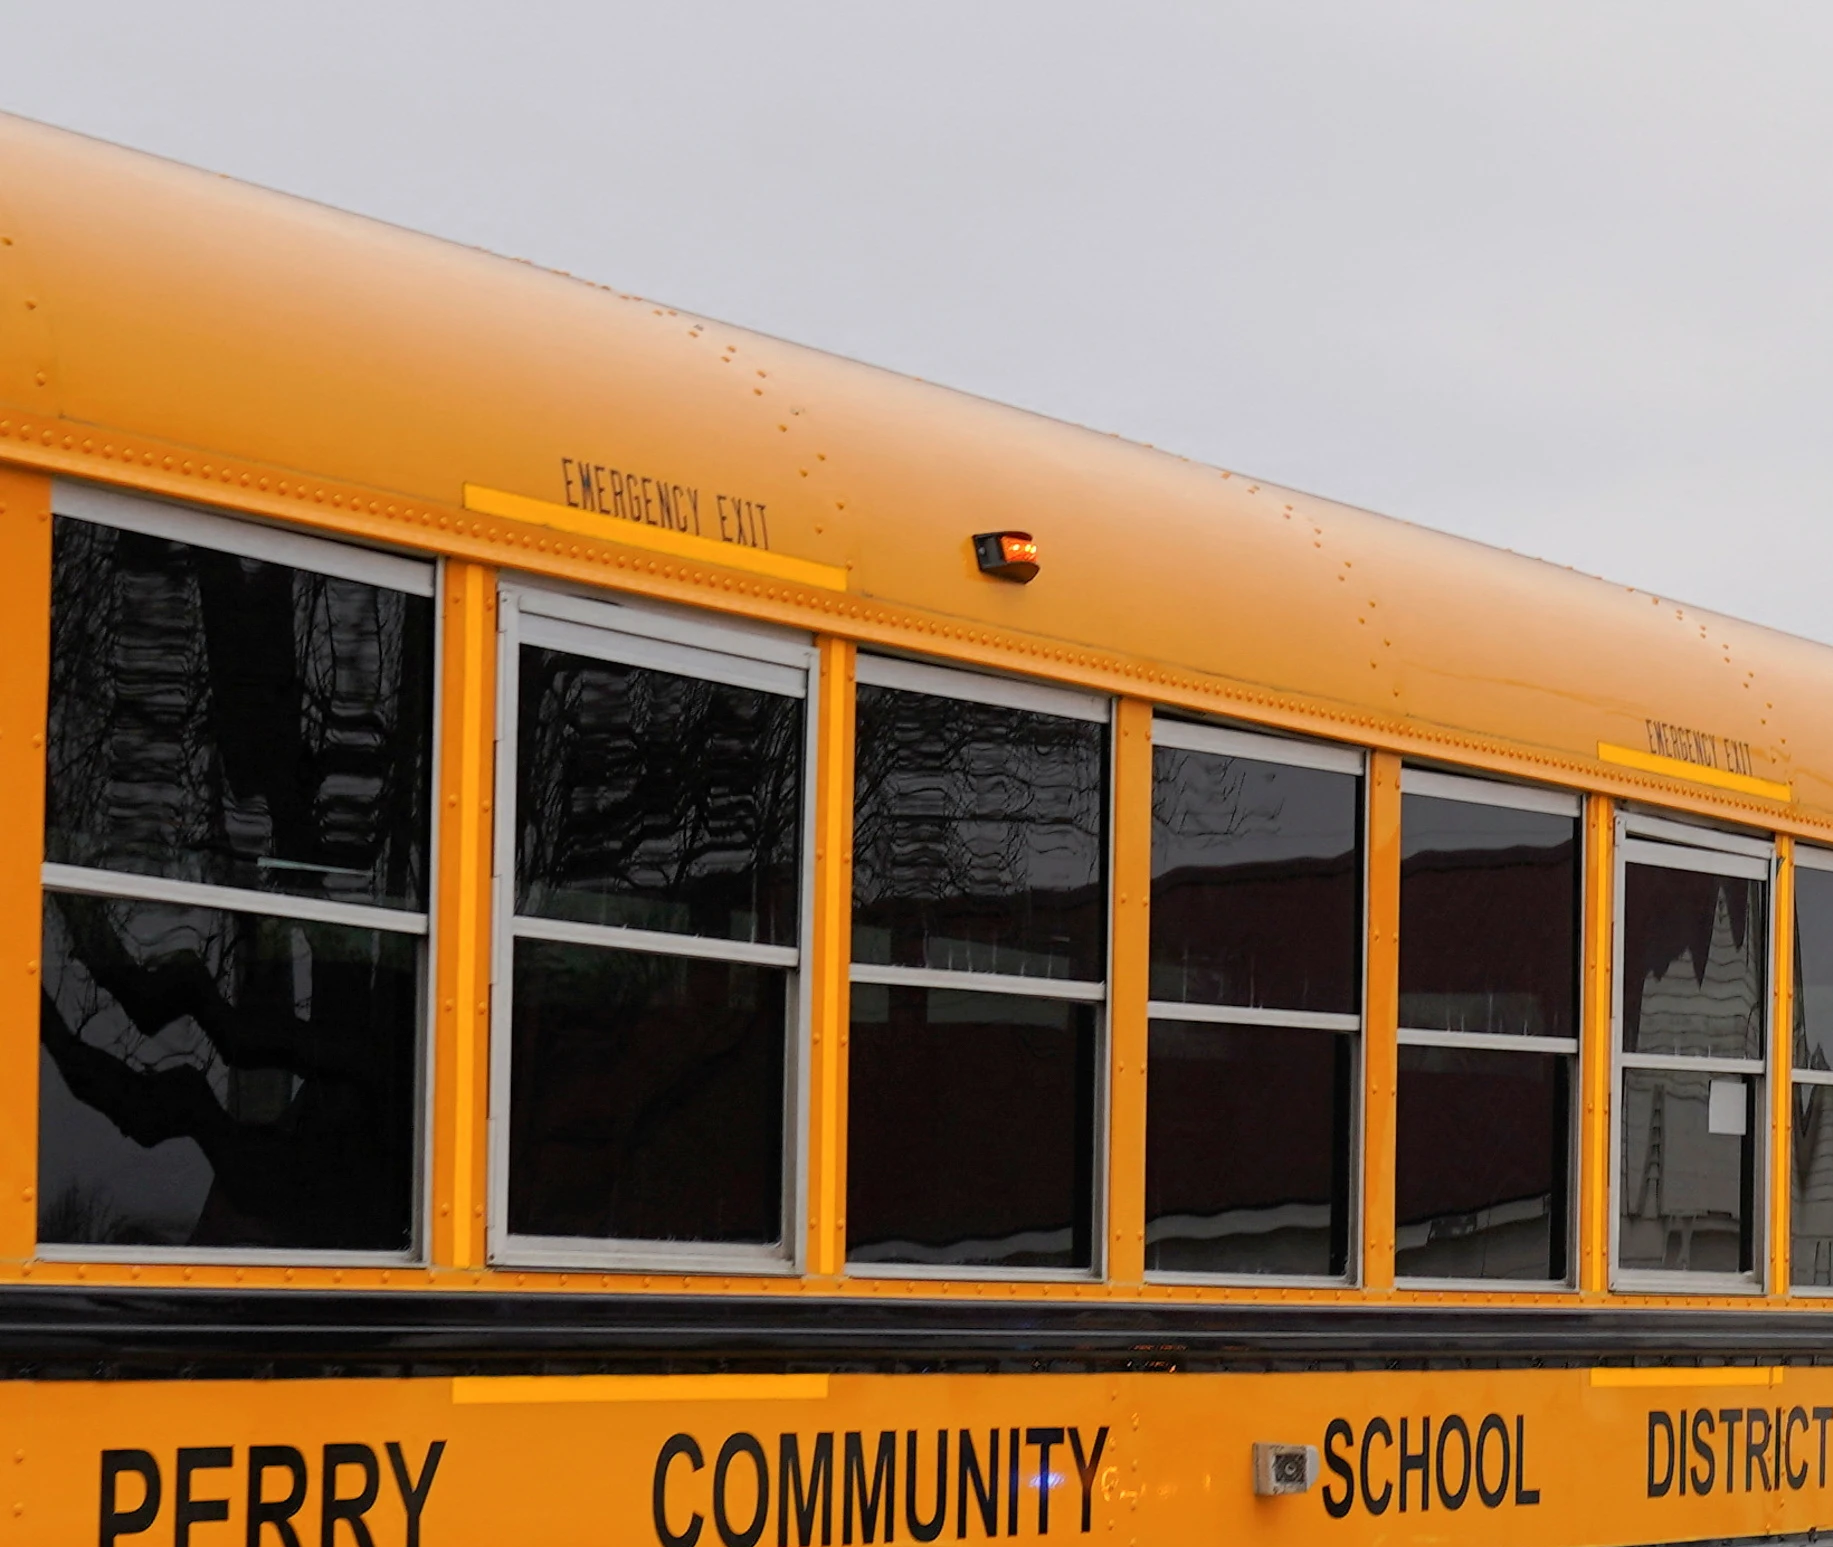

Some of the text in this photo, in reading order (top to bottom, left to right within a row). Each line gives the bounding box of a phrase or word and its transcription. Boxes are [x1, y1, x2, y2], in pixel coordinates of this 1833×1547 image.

[562, 457, 769, 550] EMERGENCY EXIT
[1645, 719, 1753, 777] EMERGENCY EXIT
[1321, 1413, 1541, 1519] SCHOOL
